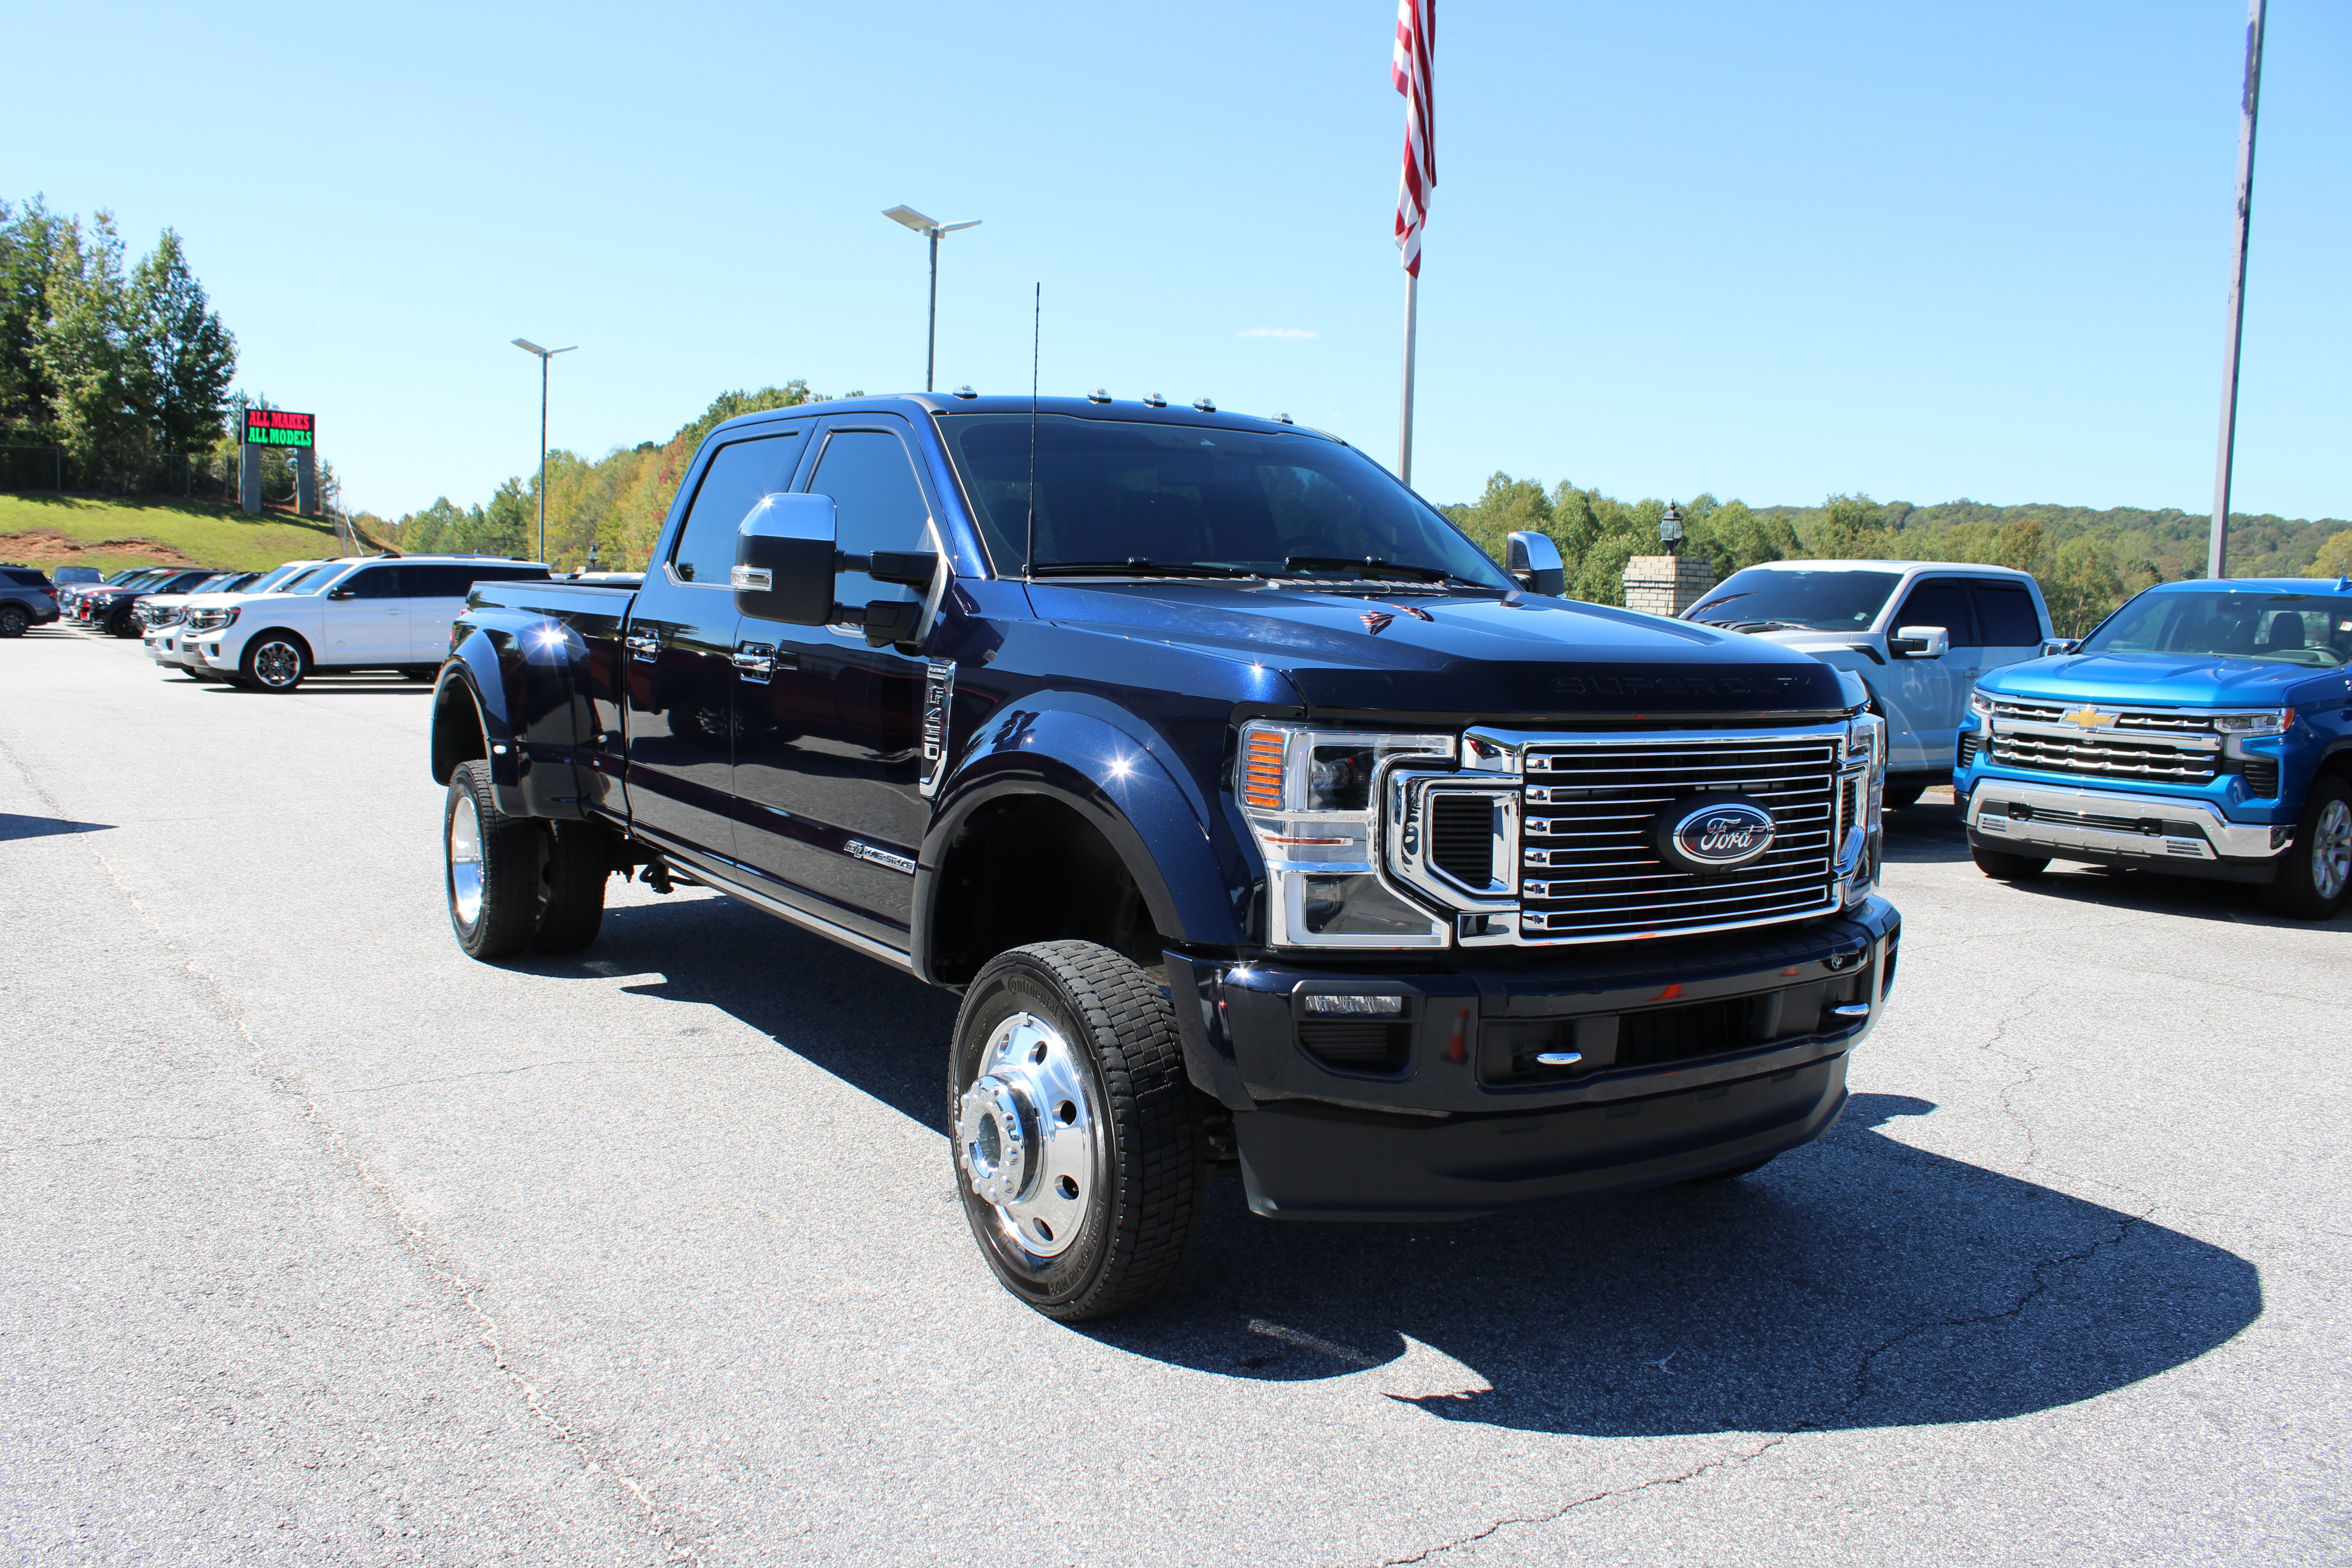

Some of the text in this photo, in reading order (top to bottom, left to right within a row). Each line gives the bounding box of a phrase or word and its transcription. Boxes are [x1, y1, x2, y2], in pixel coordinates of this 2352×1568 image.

[248, 410, 310, 430] ALL MAKES
[248, 427, 312, 446] ALL MODELS
[1551, 677, 1814, 694] SUPER DUTY
[1700, 817, 1753, 851] Ford
[1008, 976, 1059, 1018] Continental
